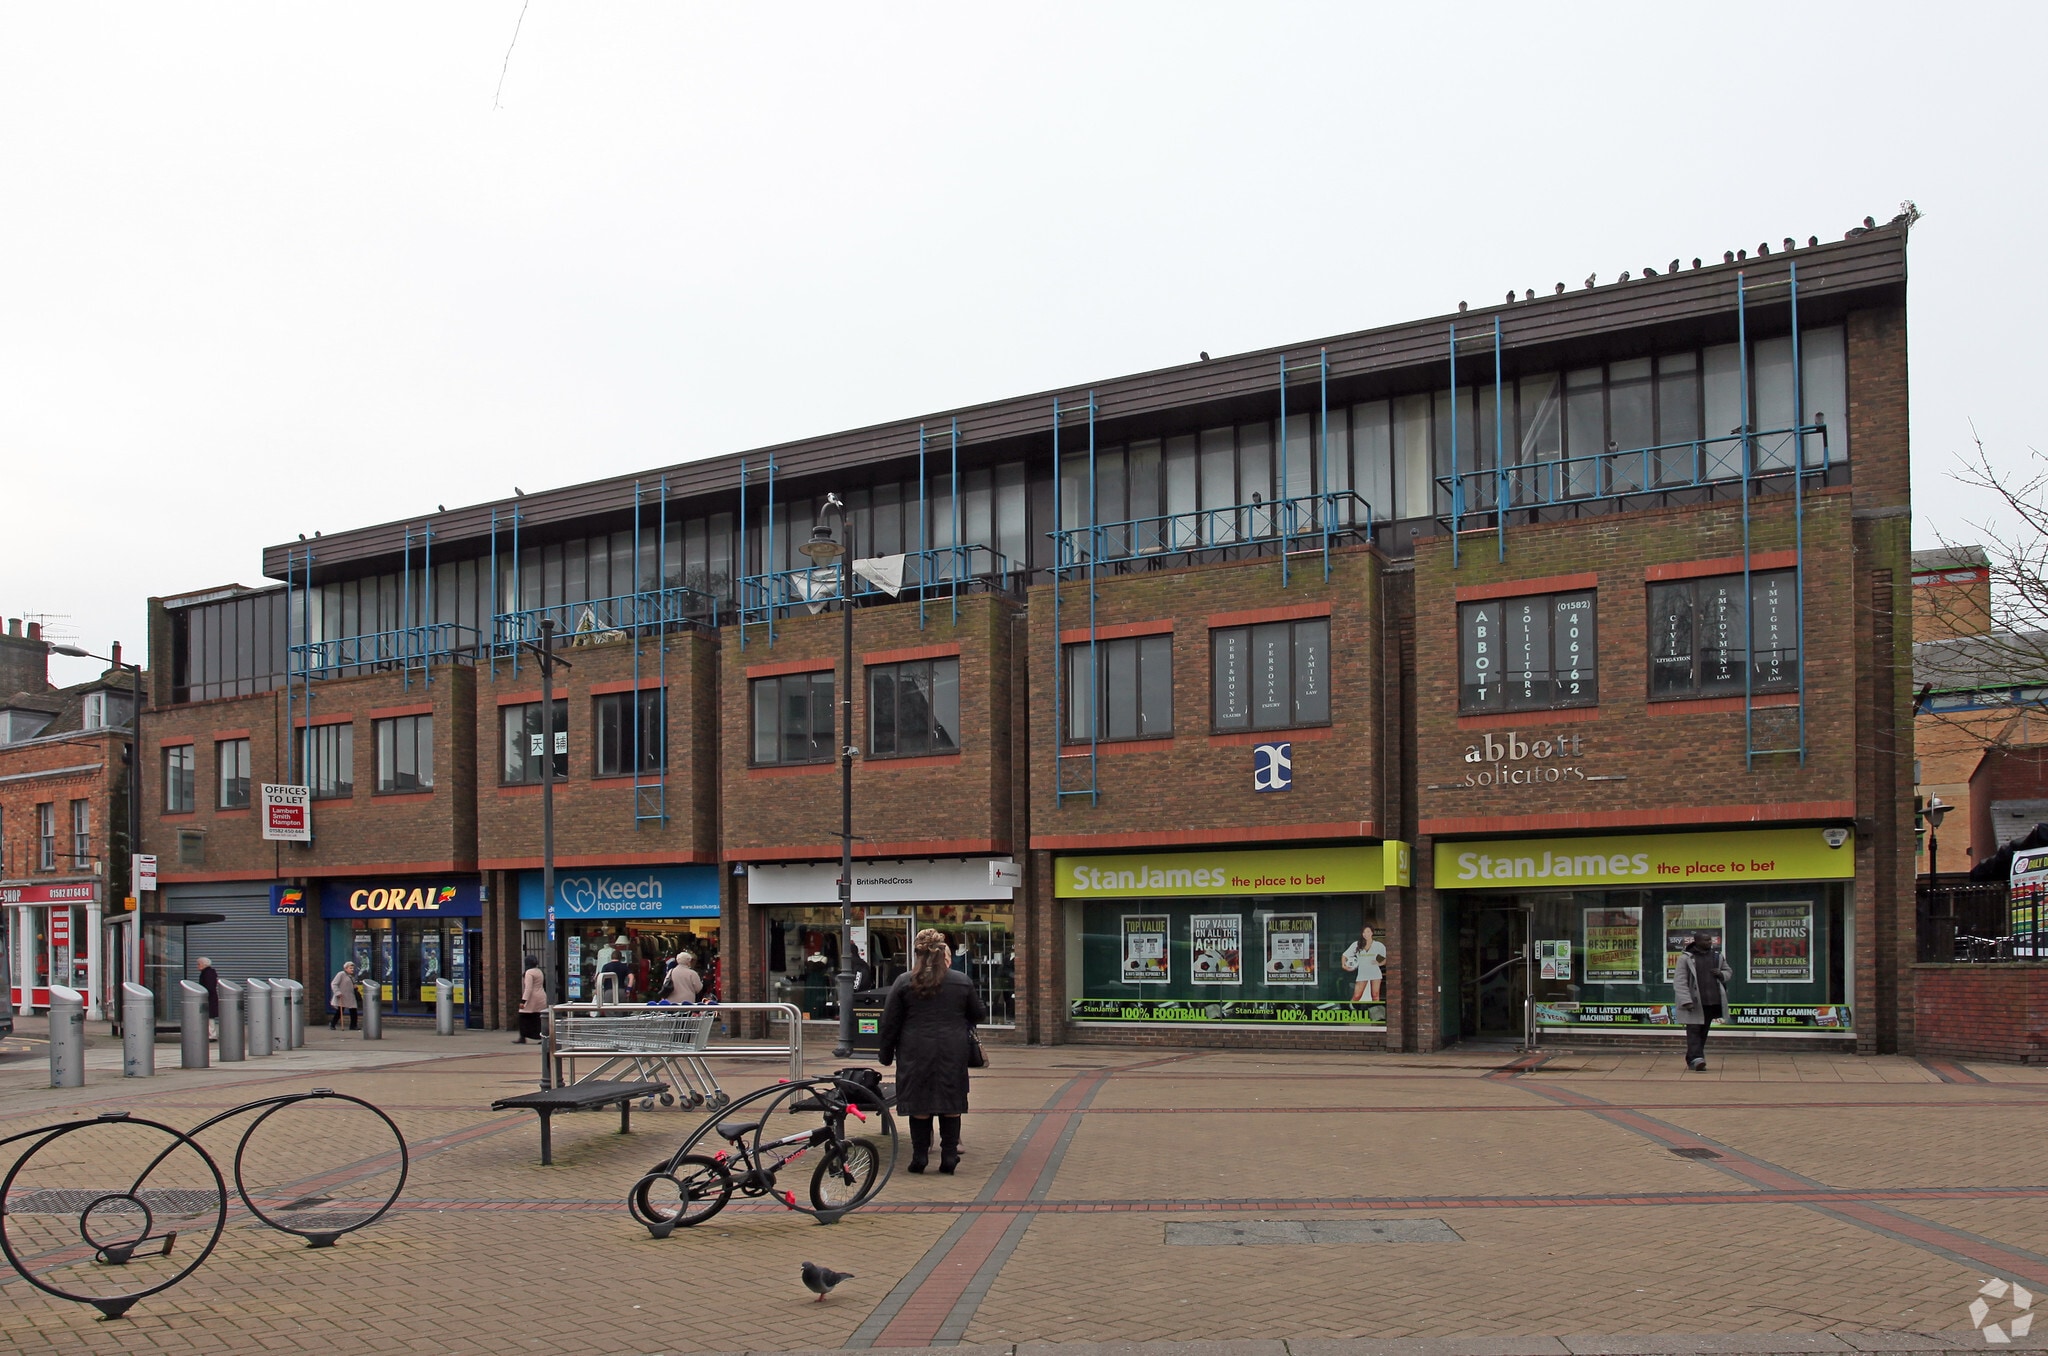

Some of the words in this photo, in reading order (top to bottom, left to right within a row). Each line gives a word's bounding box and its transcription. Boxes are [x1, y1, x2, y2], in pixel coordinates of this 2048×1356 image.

[1557, 600, 1591, 612] (01582)
[1718, 589, 1728, 673] EMPLOYMENT
[1769, 581, 1779, 675] IMMIGRATION
[1475, 610, 1490, 700] ABBOTT
[1523, 606, 1532, 697] SOLICITORS
[1569, 614, 1580, 694] 406762
[532, 738, 543, 752] 天
[1464, 731, 1586, 763] abbott
[1465, 763, 1585, 787] solicitors
[265, 786, 307, 796] OFFICES
[268, 795, 283, 803] TO
[286, 796, 304, 804] LET
[272, 819, 302, 827] Hampton
[1657, 862, 1681, 874] the
[1685, 860, 1726, 876] place
[1730, 861, 1746, 873] to
[1750, 859, 1775, 872] bet
[597, 875, 662, 900] Keech
[1231, 876, 1251, 887] the
[1254, 875, 1287, 889] place
[1290, 876, 1302, 886] to
[1306, 874, 1326, 886] bet
[3, 889, 21, 902] SHOP
[350, 887, 441, 911] CORAL
[597, 900, 637, 912] hospice
[639, 901, 662, 910] care
[1126, 921, 1140, 932] TOP
[1142, 921, 1166, 932] VALUE
[1195, 920, 1210, 928] TOP
[1212, 919, 1237, 928] VALUE
[1268, 920, 1278, 931] ALL
[1280, 920, 1290, 931] THE
[1292, 920, 1313, 931] ACTION
[1195, 929, 1206, 937] ON
[1208, 929, 1221, 937] ALL
[1223, 929, 1237, 937] THE
[1753, 927, 1807, 938] RETURNS
[1195, 938, 1237, 951] ACTION
[1588, 939, 1609, 950] BEST
[1613, 939, 1638, 949] PRICE
[1121, 1007, 1150, 1019] 100%
[1153, 1007, 1207, 1019] FOOTBALL
[1276, 1009, 1308, 1021] 100%
[1311, 1009, 1370, 1021] FOOTBALL
[1623, 1006, 1651, 1014] GAMING
[1737, 1016, 1775, 1024] MACHINES
